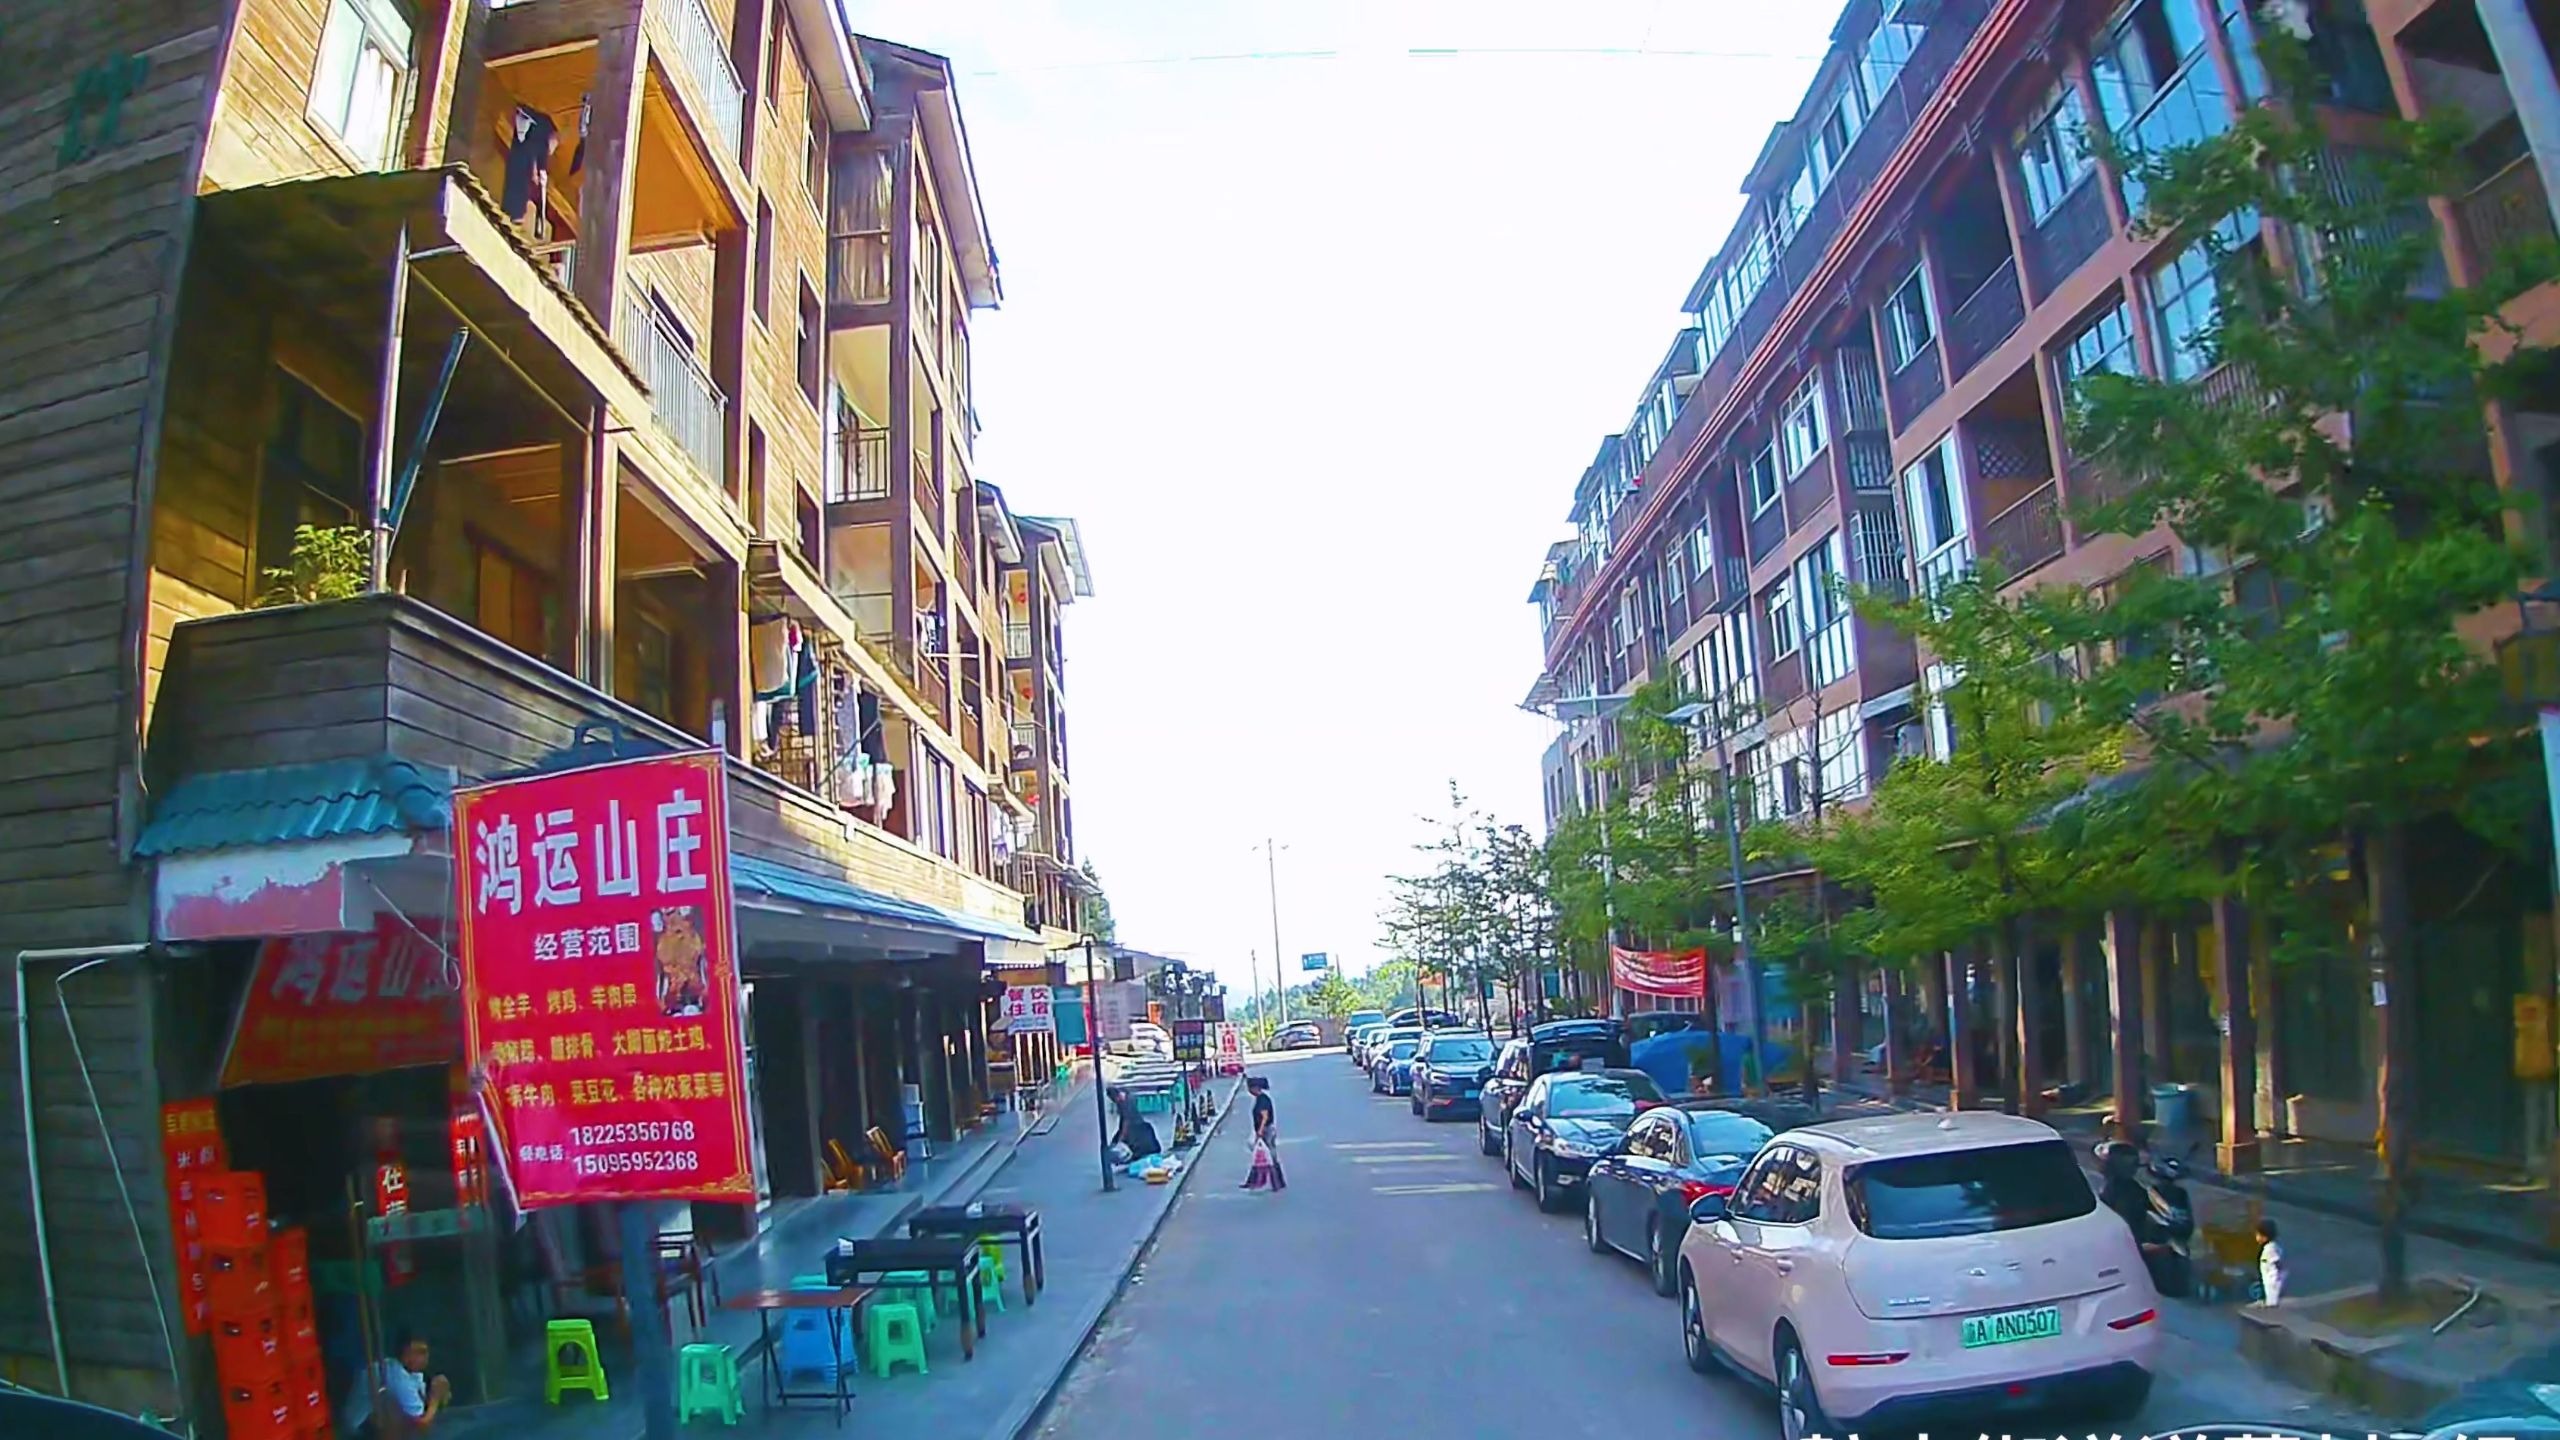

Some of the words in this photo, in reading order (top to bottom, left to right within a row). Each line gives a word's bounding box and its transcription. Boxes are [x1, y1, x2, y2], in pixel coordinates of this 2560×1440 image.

[476, 788, 707, 915] 鸿运山庄
[534, 922, 641, 961] 经营范围
[570, 1120, 695, 1146] 18225356768
[574, 1151, 699, 1175] 15095952368
